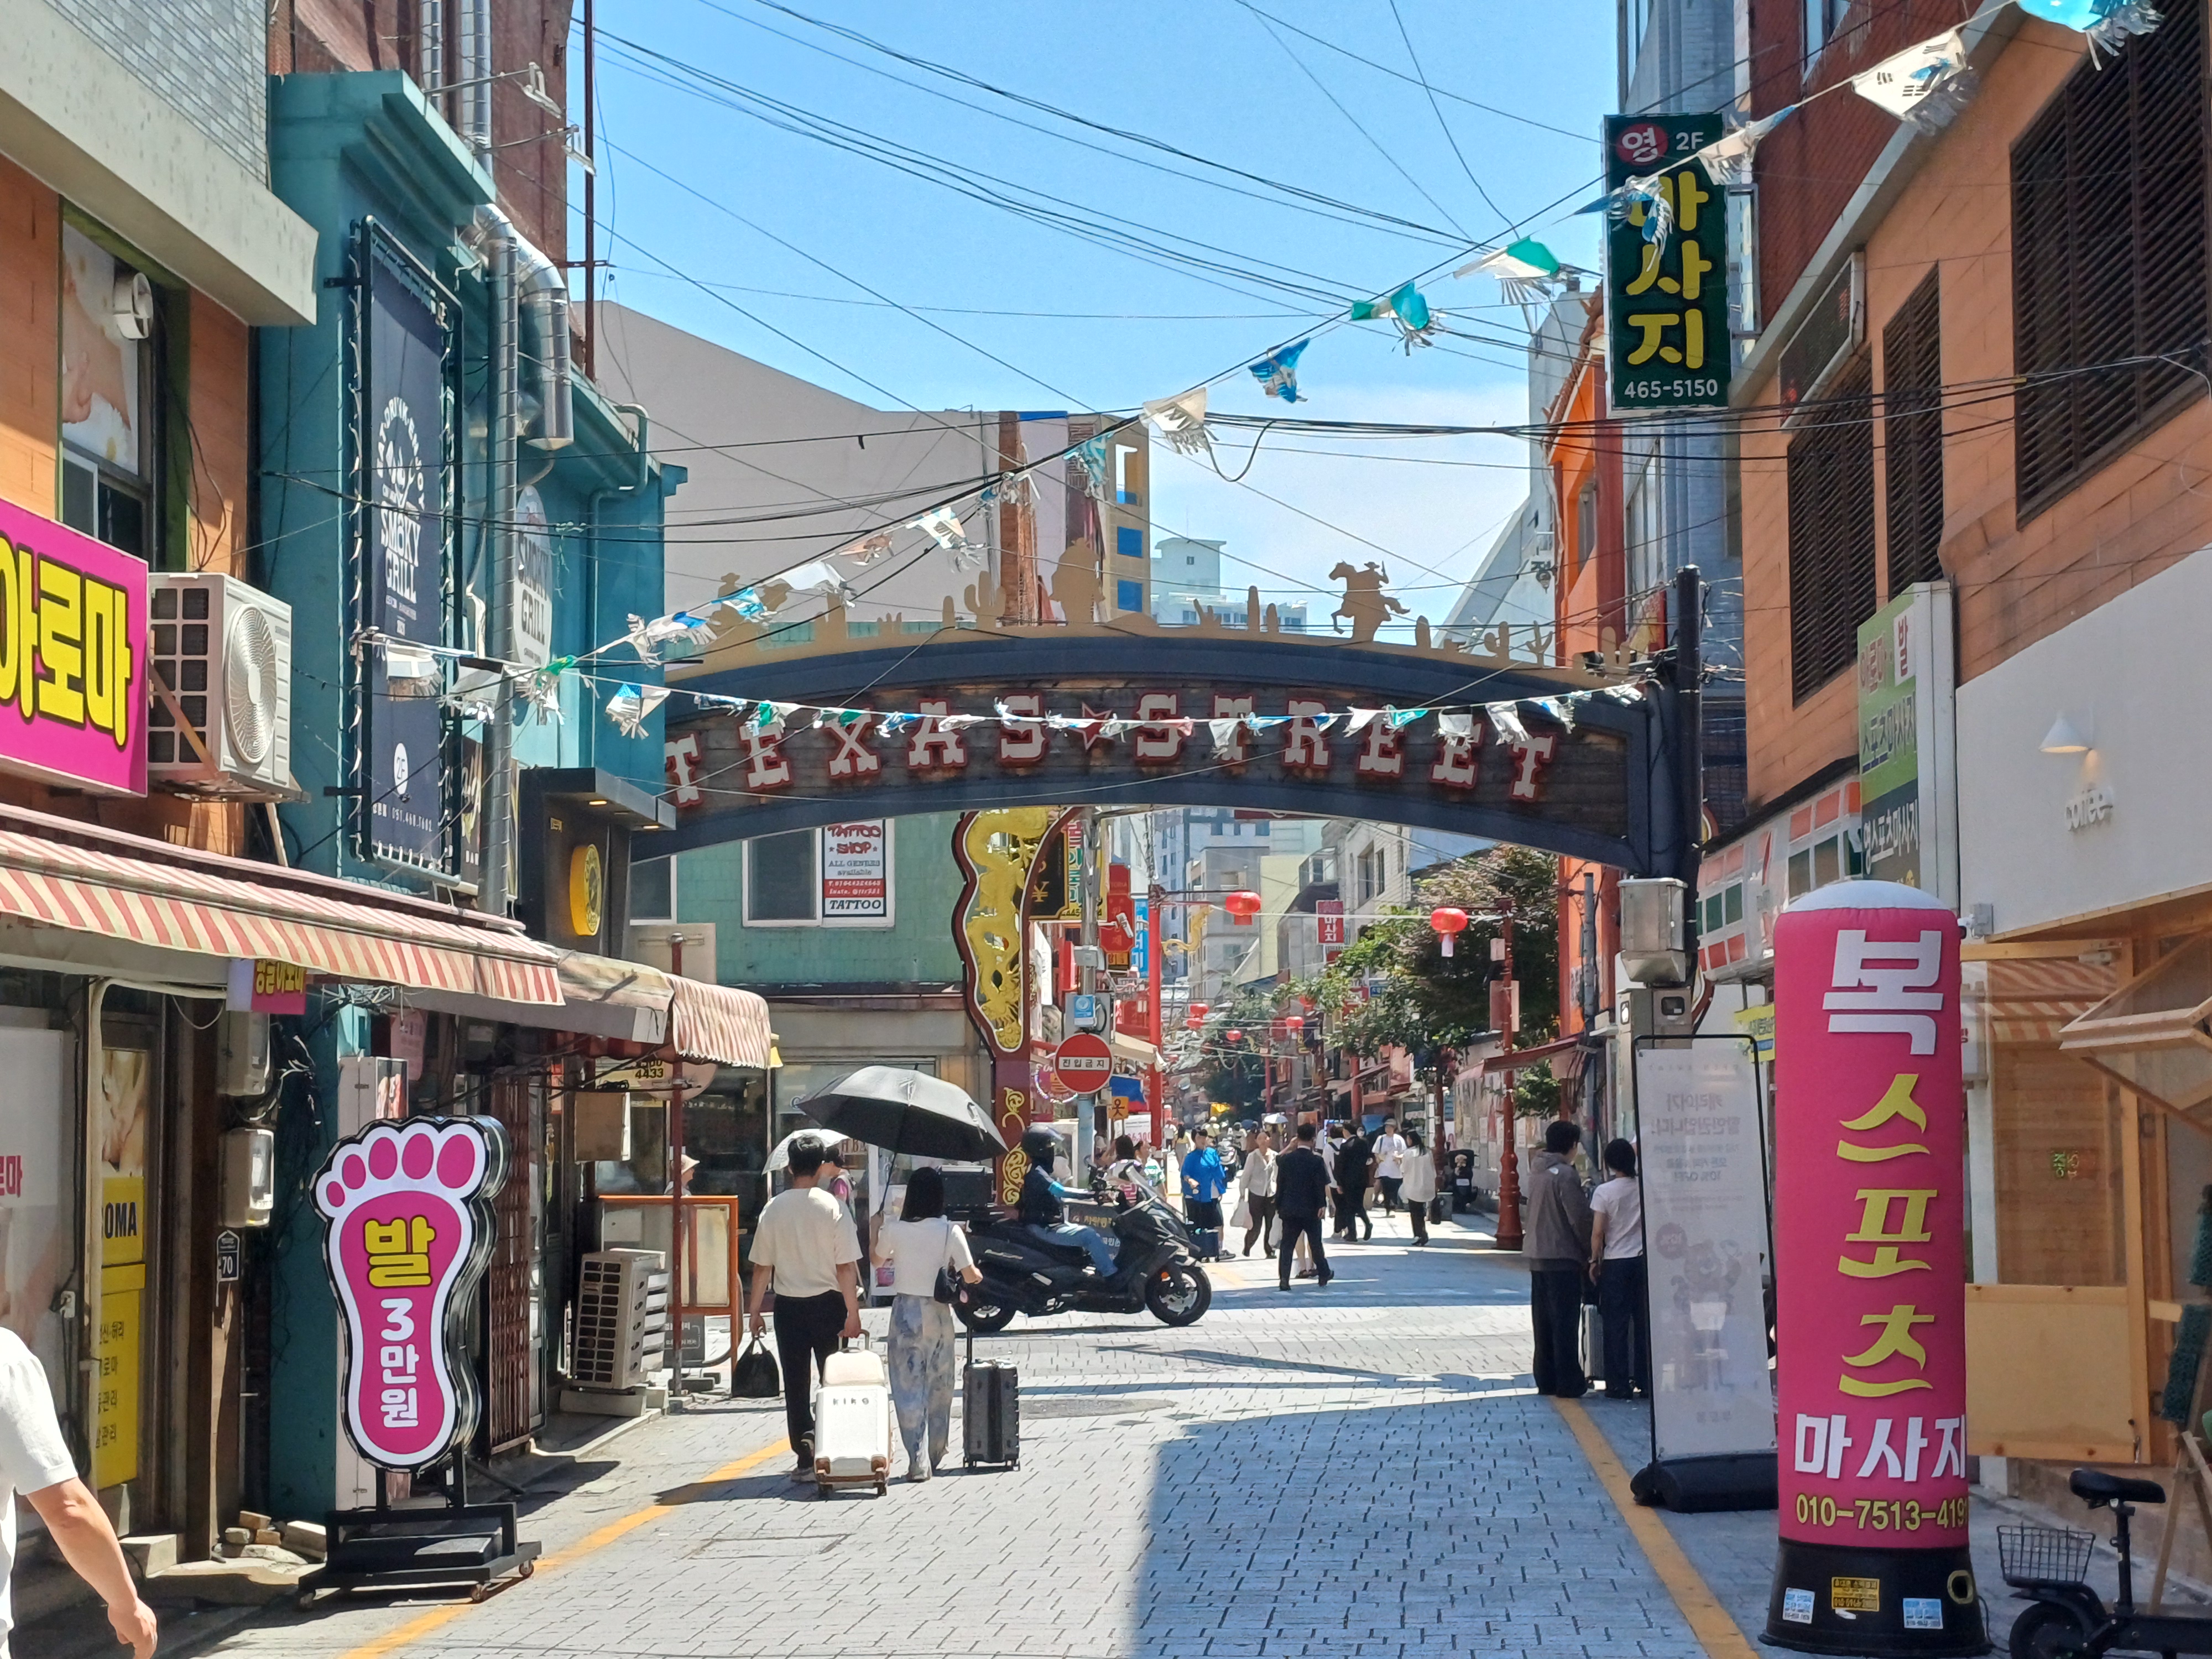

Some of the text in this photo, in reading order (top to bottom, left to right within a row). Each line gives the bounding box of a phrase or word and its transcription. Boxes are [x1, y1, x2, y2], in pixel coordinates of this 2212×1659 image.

[1621, 127, 1658, 163] 영
[1676, 132, 1704, 150] 2F
[1626, 170, 1713, 369] 마사지
[1624, 378, 1718, 398] 465-5150
[380, 501, 421, 568] SMOKY
[385, 547, 418, 604] GRILL
[521, 589, 545, 646] GRILL
[1898, 615, 1909, 677] 발
[396, 756, 406, 780] 2F
[664, 692, 1048, 807] TEXAS
[1134, 691, 1554, 800] STREET
[827, 824, 881, 838] TATTOO
[836, 841, 872, 854] SHOP
[1863, 799, 1919, 875] 영스포츠마사지
[830, 900, 881, 910] TATTOO
[1822, 930, 1944, 1056] 복
[635, 1067, 664, 1079] 4433
[1063, 1058, 1105, 1068] 진입금지
[102, 1202, 137, 1239] OMA
[222, 1256, 233, 1274] 70
[364, 1215, 436, 1287] 발
[380, 1298, 420, 1429] 3만원
[1794, 1413, 1967, 1483] 마사지
